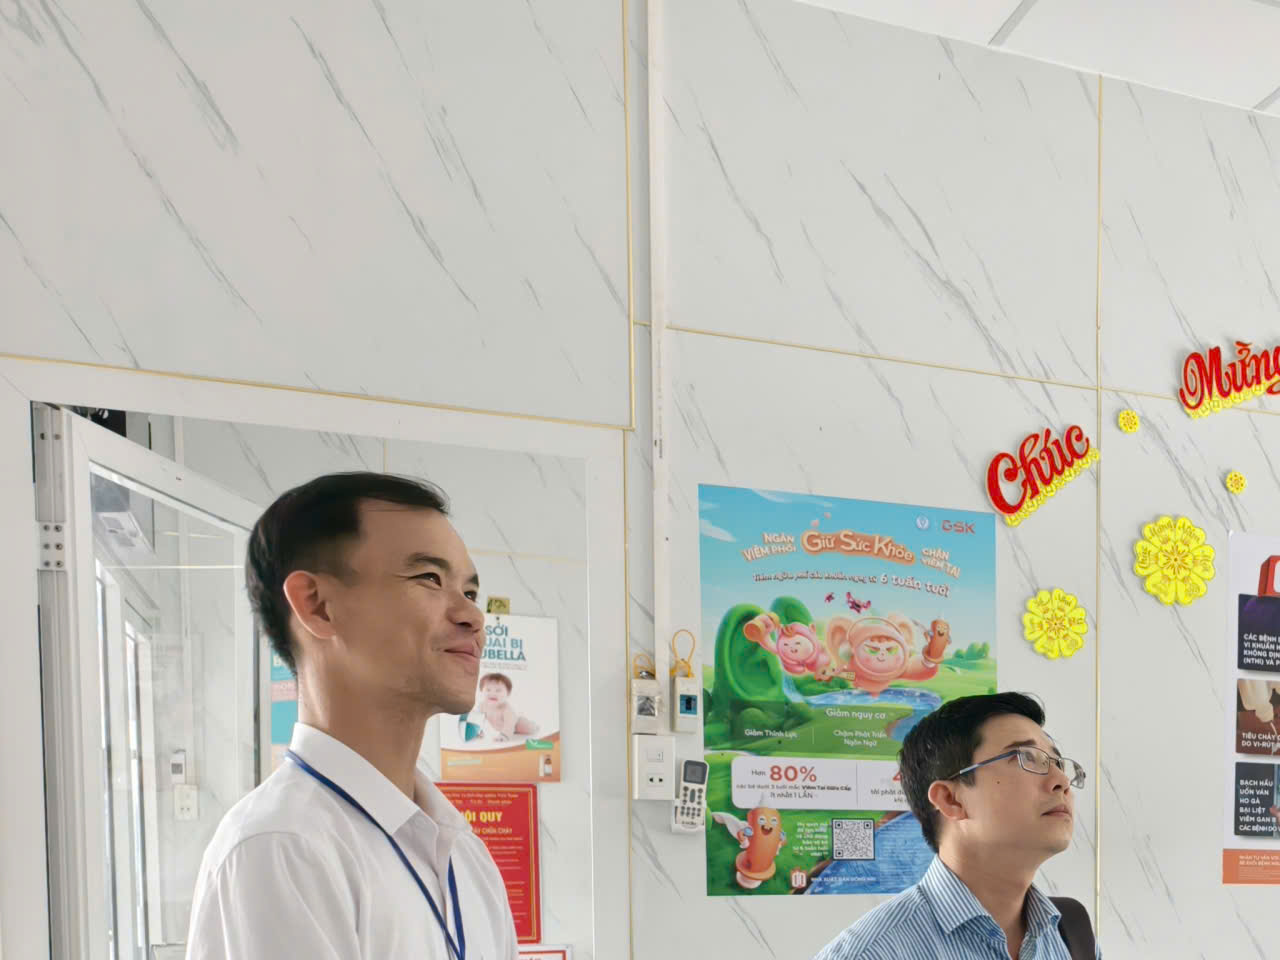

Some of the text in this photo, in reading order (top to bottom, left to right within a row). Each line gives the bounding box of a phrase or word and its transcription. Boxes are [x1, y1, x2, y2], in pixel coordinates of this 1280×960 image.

[987, 425, 1090, 515] Chúc
[942, 520, 976, 534] GSK
[802, 530, 836, 551] Giữ
[840, 530, 871, 552] Sức
[880, 573, 889, 584] 6
[826, 708, 850, 719] Giảm
[852, 711, 873, 720] nguy
[769, 765, 817, 783] 80%
[463, 809, 503, 824] ỘI QUY
